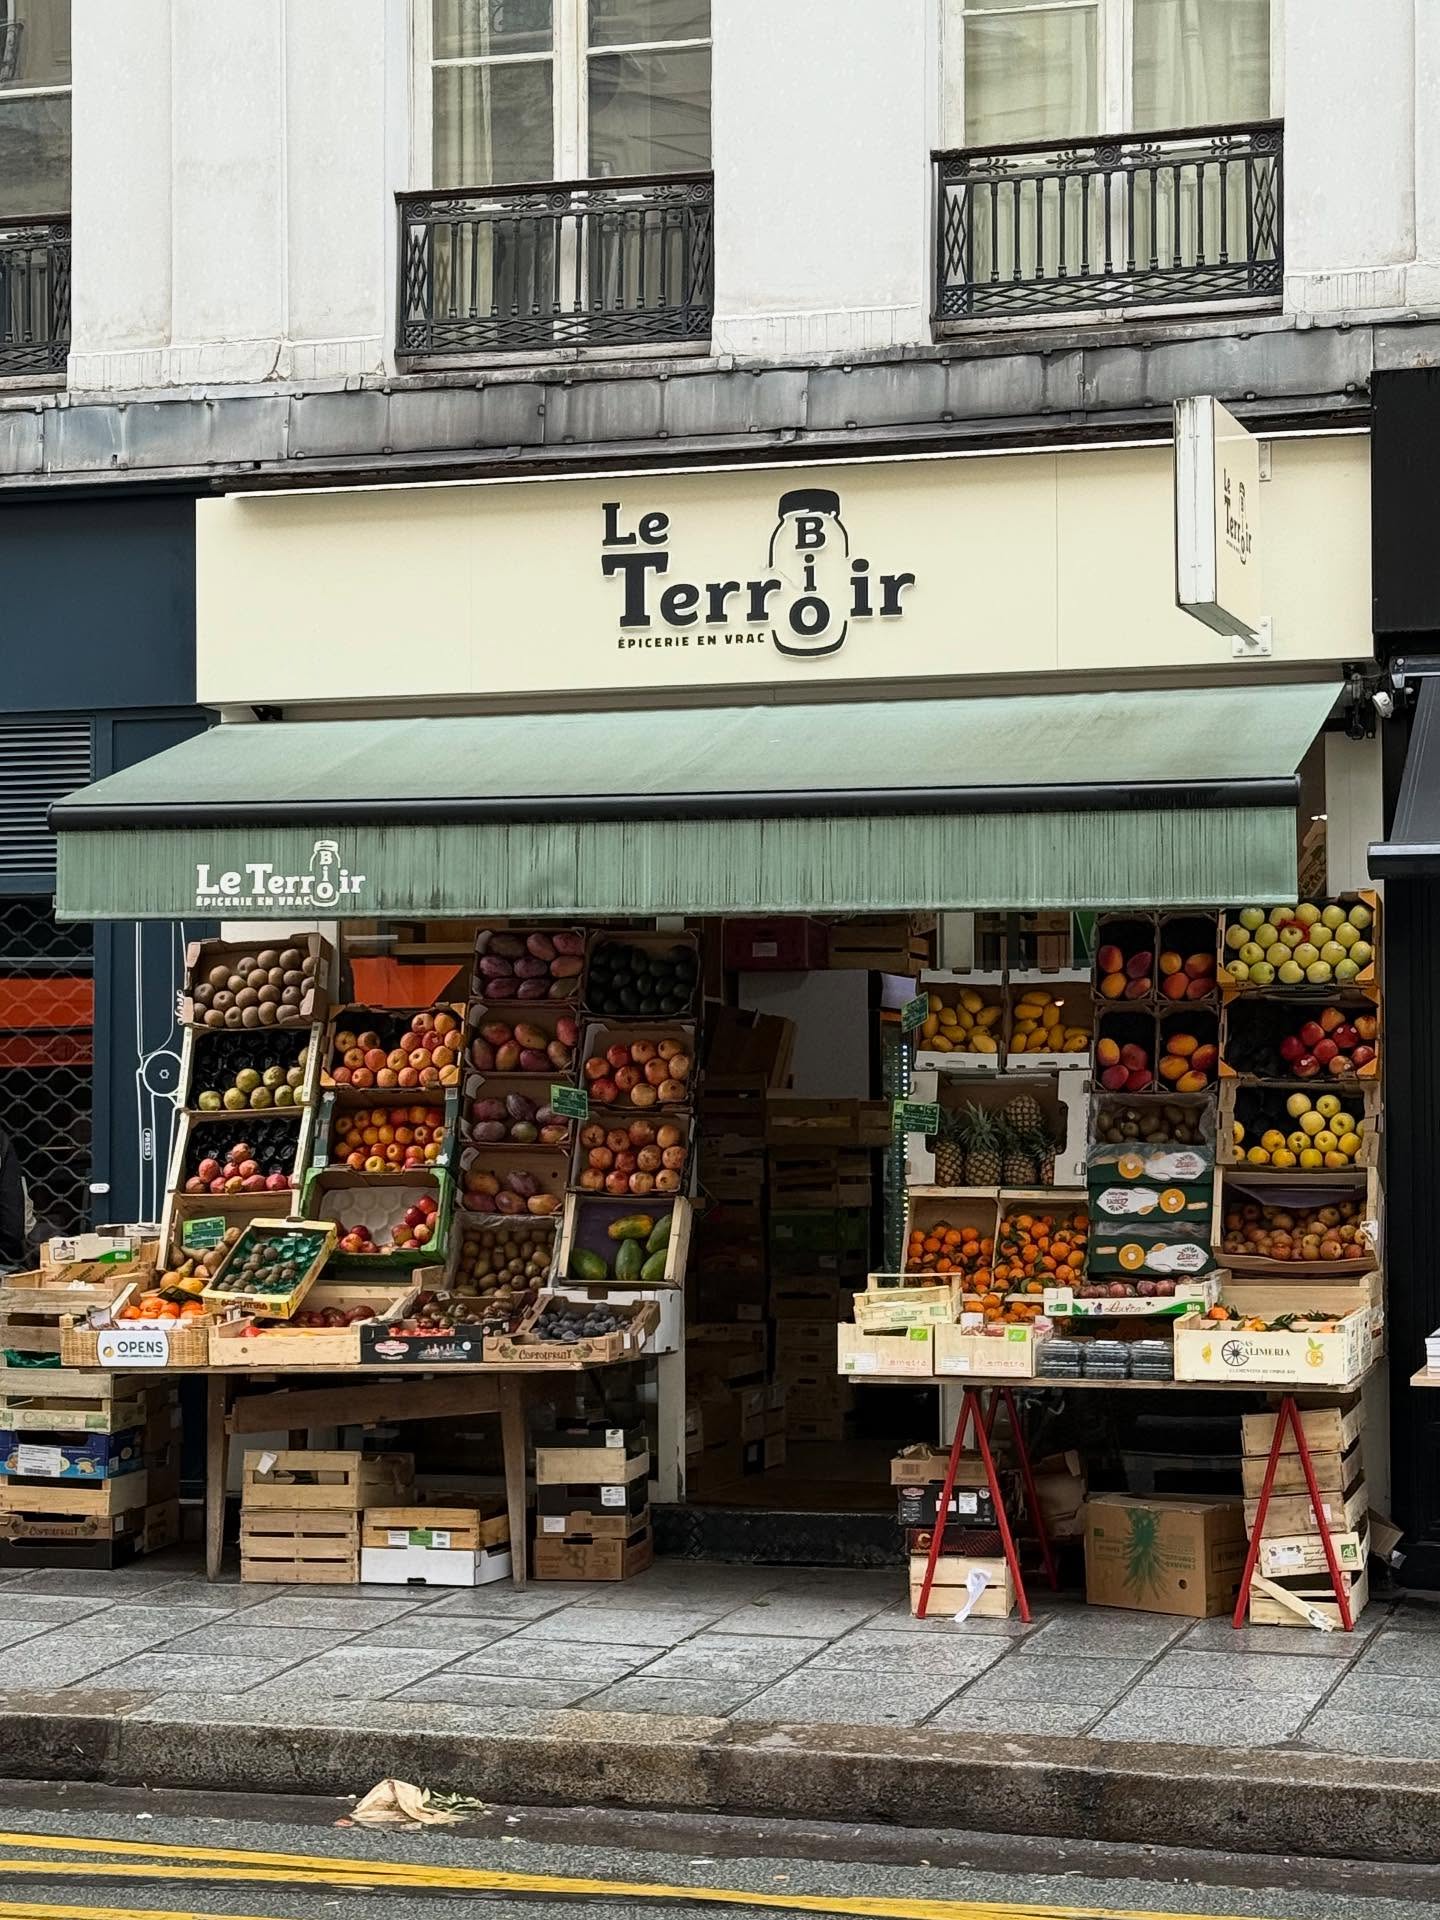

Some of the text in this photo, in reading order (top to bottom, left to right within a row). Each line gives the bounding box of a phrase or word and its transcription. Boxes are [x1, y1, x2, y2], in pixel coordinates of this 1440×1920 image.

[602, 502, 669, 546] Le
[601, 552, 916, 636] Terroir
[618, 632, 765, 649] ÉPICERIE EN VRAC
[196, 863, 366, 899] Le Terroir
[257, 896, 274, 906] EN
[278, 896, 311, 906] VRAC
[117, 1341, 163, 1353] OPENS
